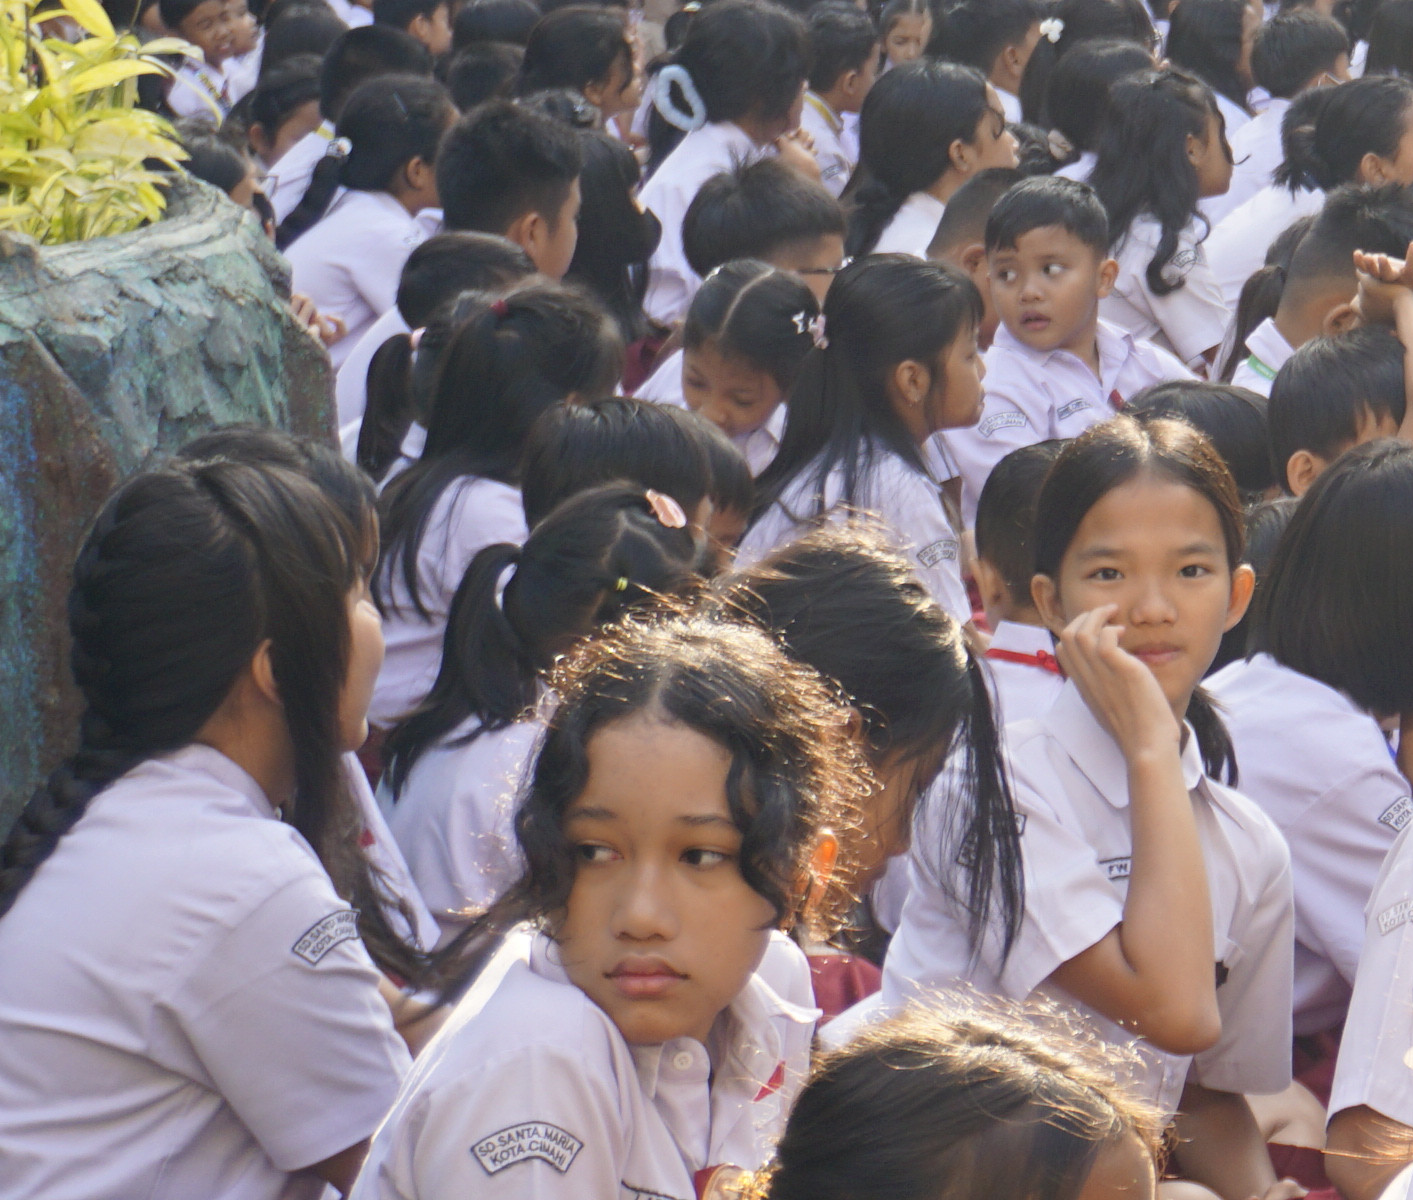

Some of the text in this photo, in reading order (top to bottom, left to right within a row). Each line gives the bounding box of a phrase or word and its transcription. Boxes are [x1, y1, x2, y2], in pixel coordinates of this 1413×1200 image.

[1393, 809, 1412, 827] KOTA
[478, 1127, 576, 1157] SD SANTA MARIA
[489, 1142, 526, 1166] KOTA
